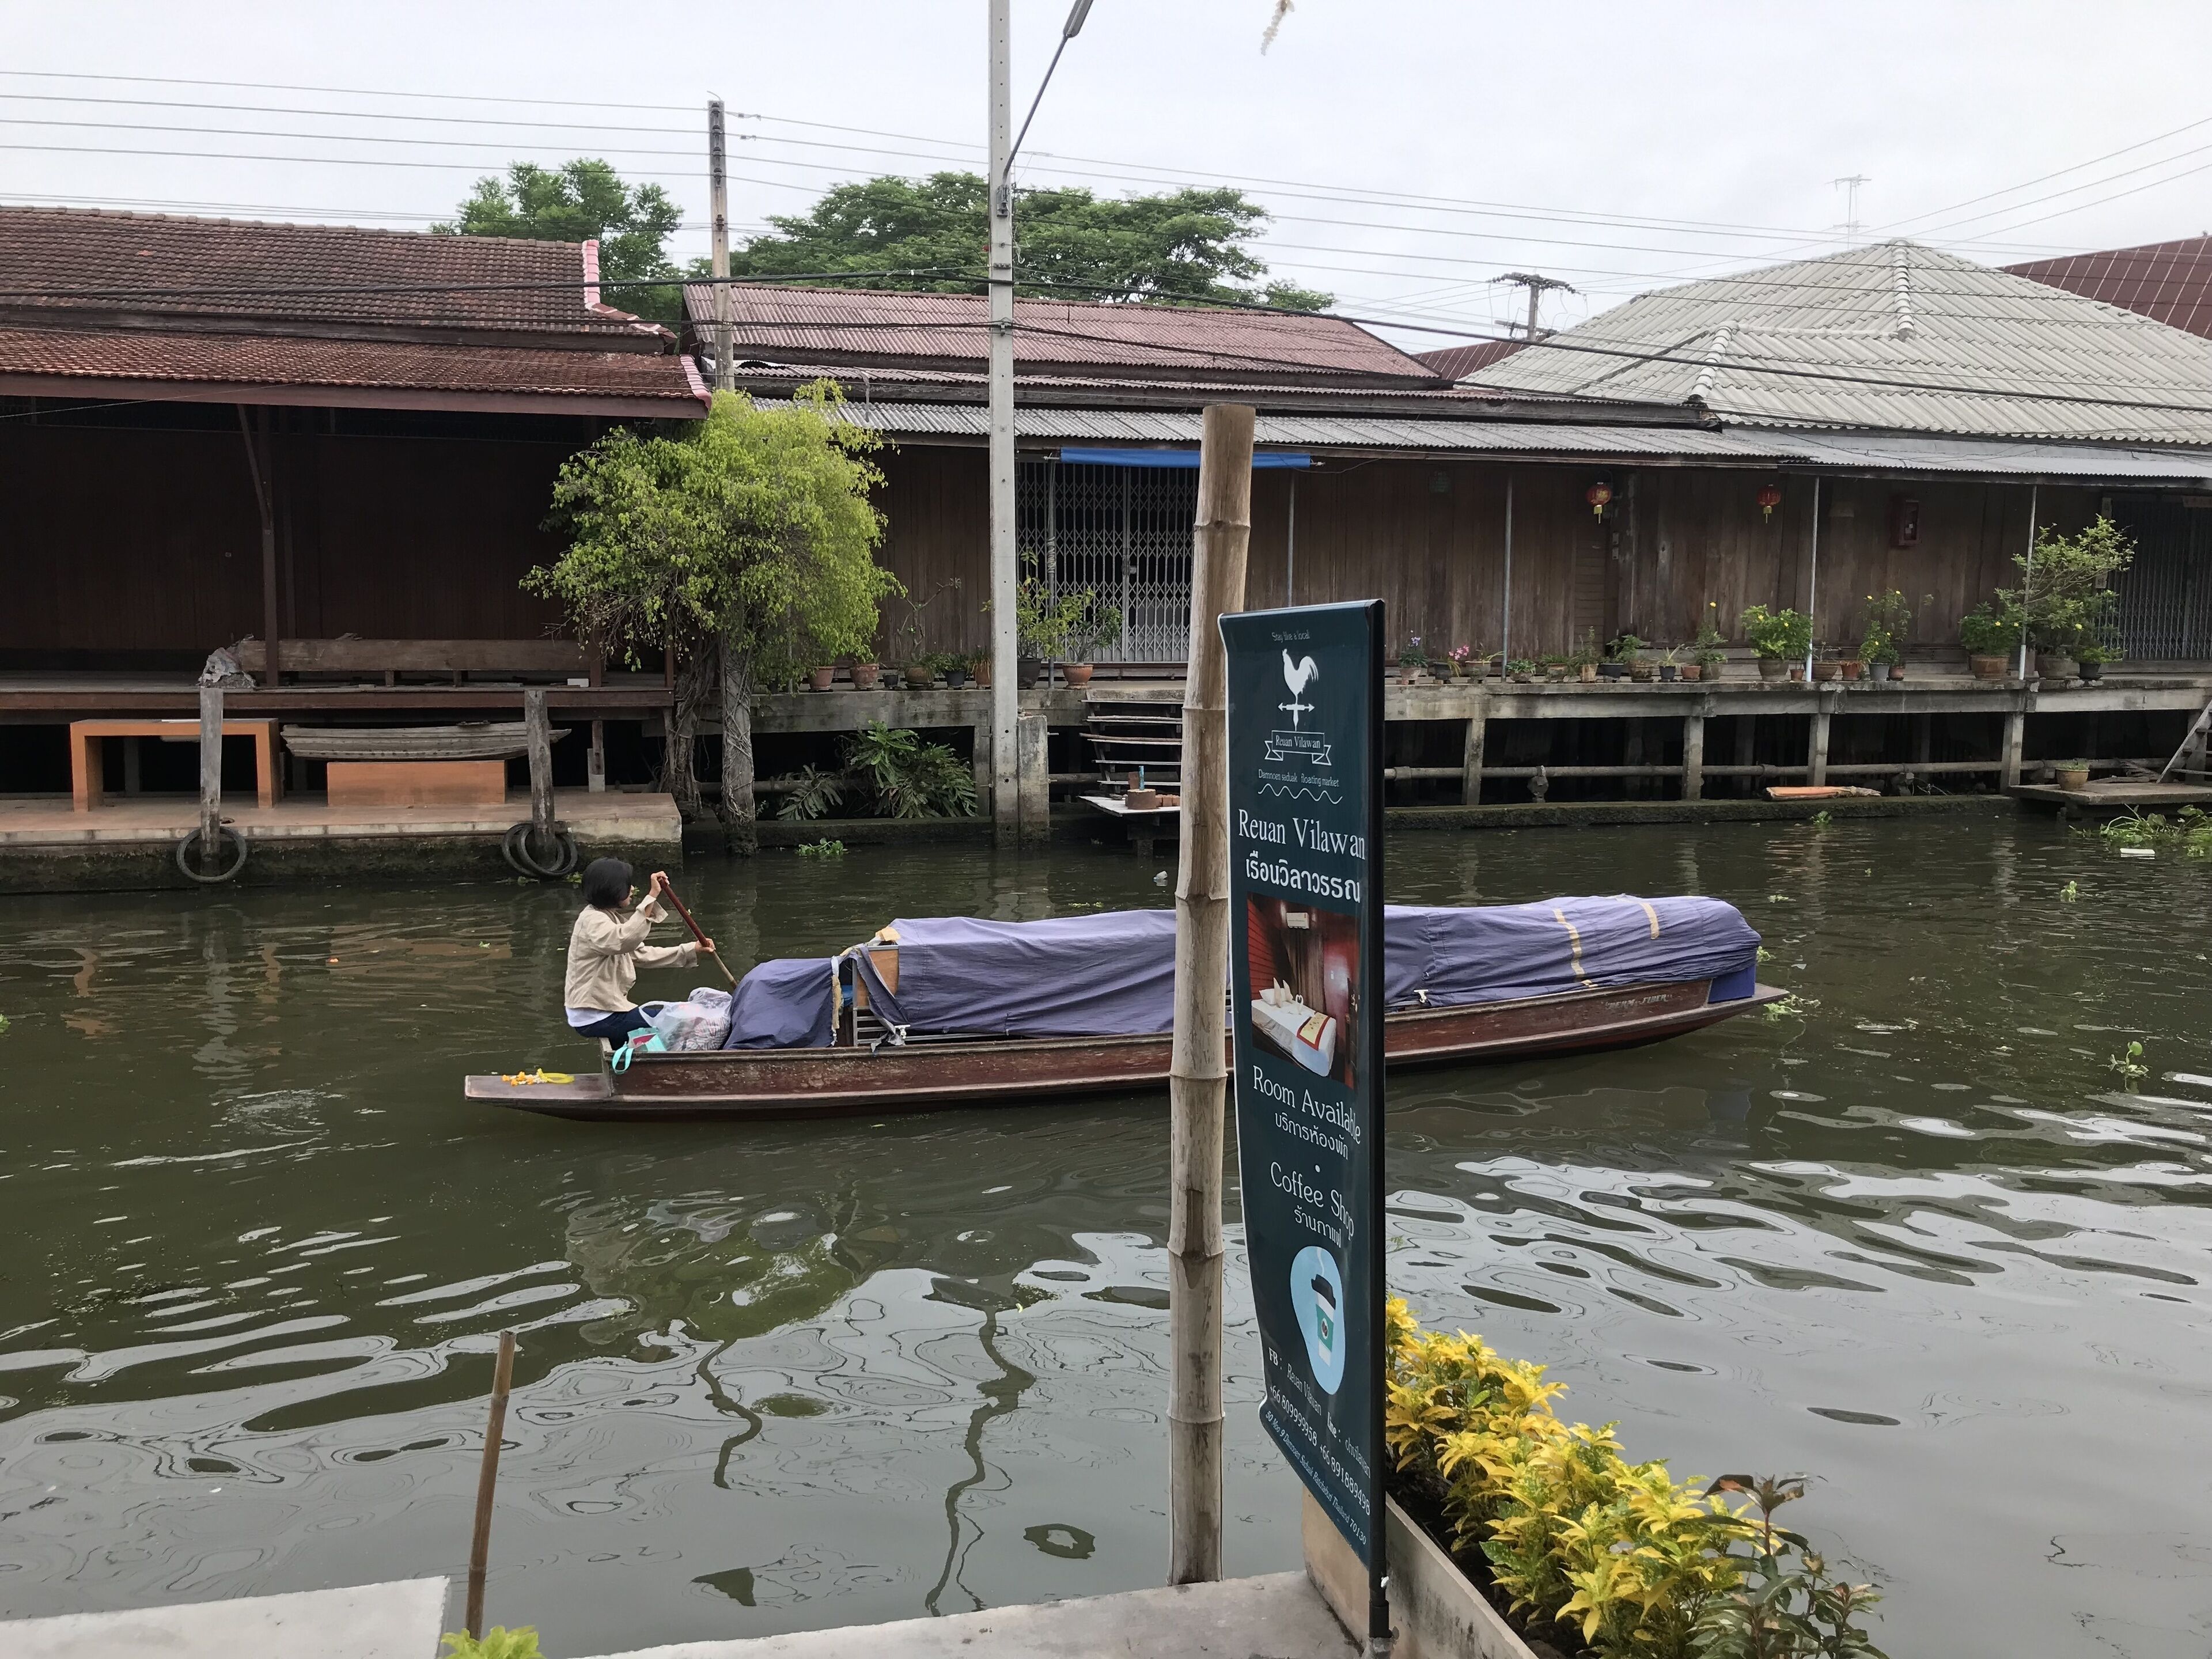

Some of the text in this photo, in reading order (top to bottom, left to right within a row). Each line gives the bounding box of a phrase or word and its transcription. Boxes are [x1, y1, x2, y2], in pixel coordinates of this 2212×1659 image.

[1271, 632, 1283, 643] Stay
[1276, 735, 1320, 748] Reuan Vilawan
[1301, 773, 1321, 787] floating
[1321, 777, 1339, 787] market
[1238, 809, 1366, 860] Reuan Vilawan
[1245, 850, 1361, 903] เรือนวิลาวรรณ
[1253, 1065, 1361, 1145] Room Available
[1275, 1112, 1349, 1160] บริการห้องพัก
[1270, 1161, 1354, 1240] Coffee Shop
[1294, 1205, 1342, 1248] ร้านกาแฟ
[1287, 1363, 1302, 1392] Reuan
[1270, 1385, 1370, 1516] +66 809999958 +66 891889498
[1266, 1411, 1274, 1422] 50
[1332, 1496, 1350, 1523] Thailand
[1350, 1518, 1366, 1545] 70130
